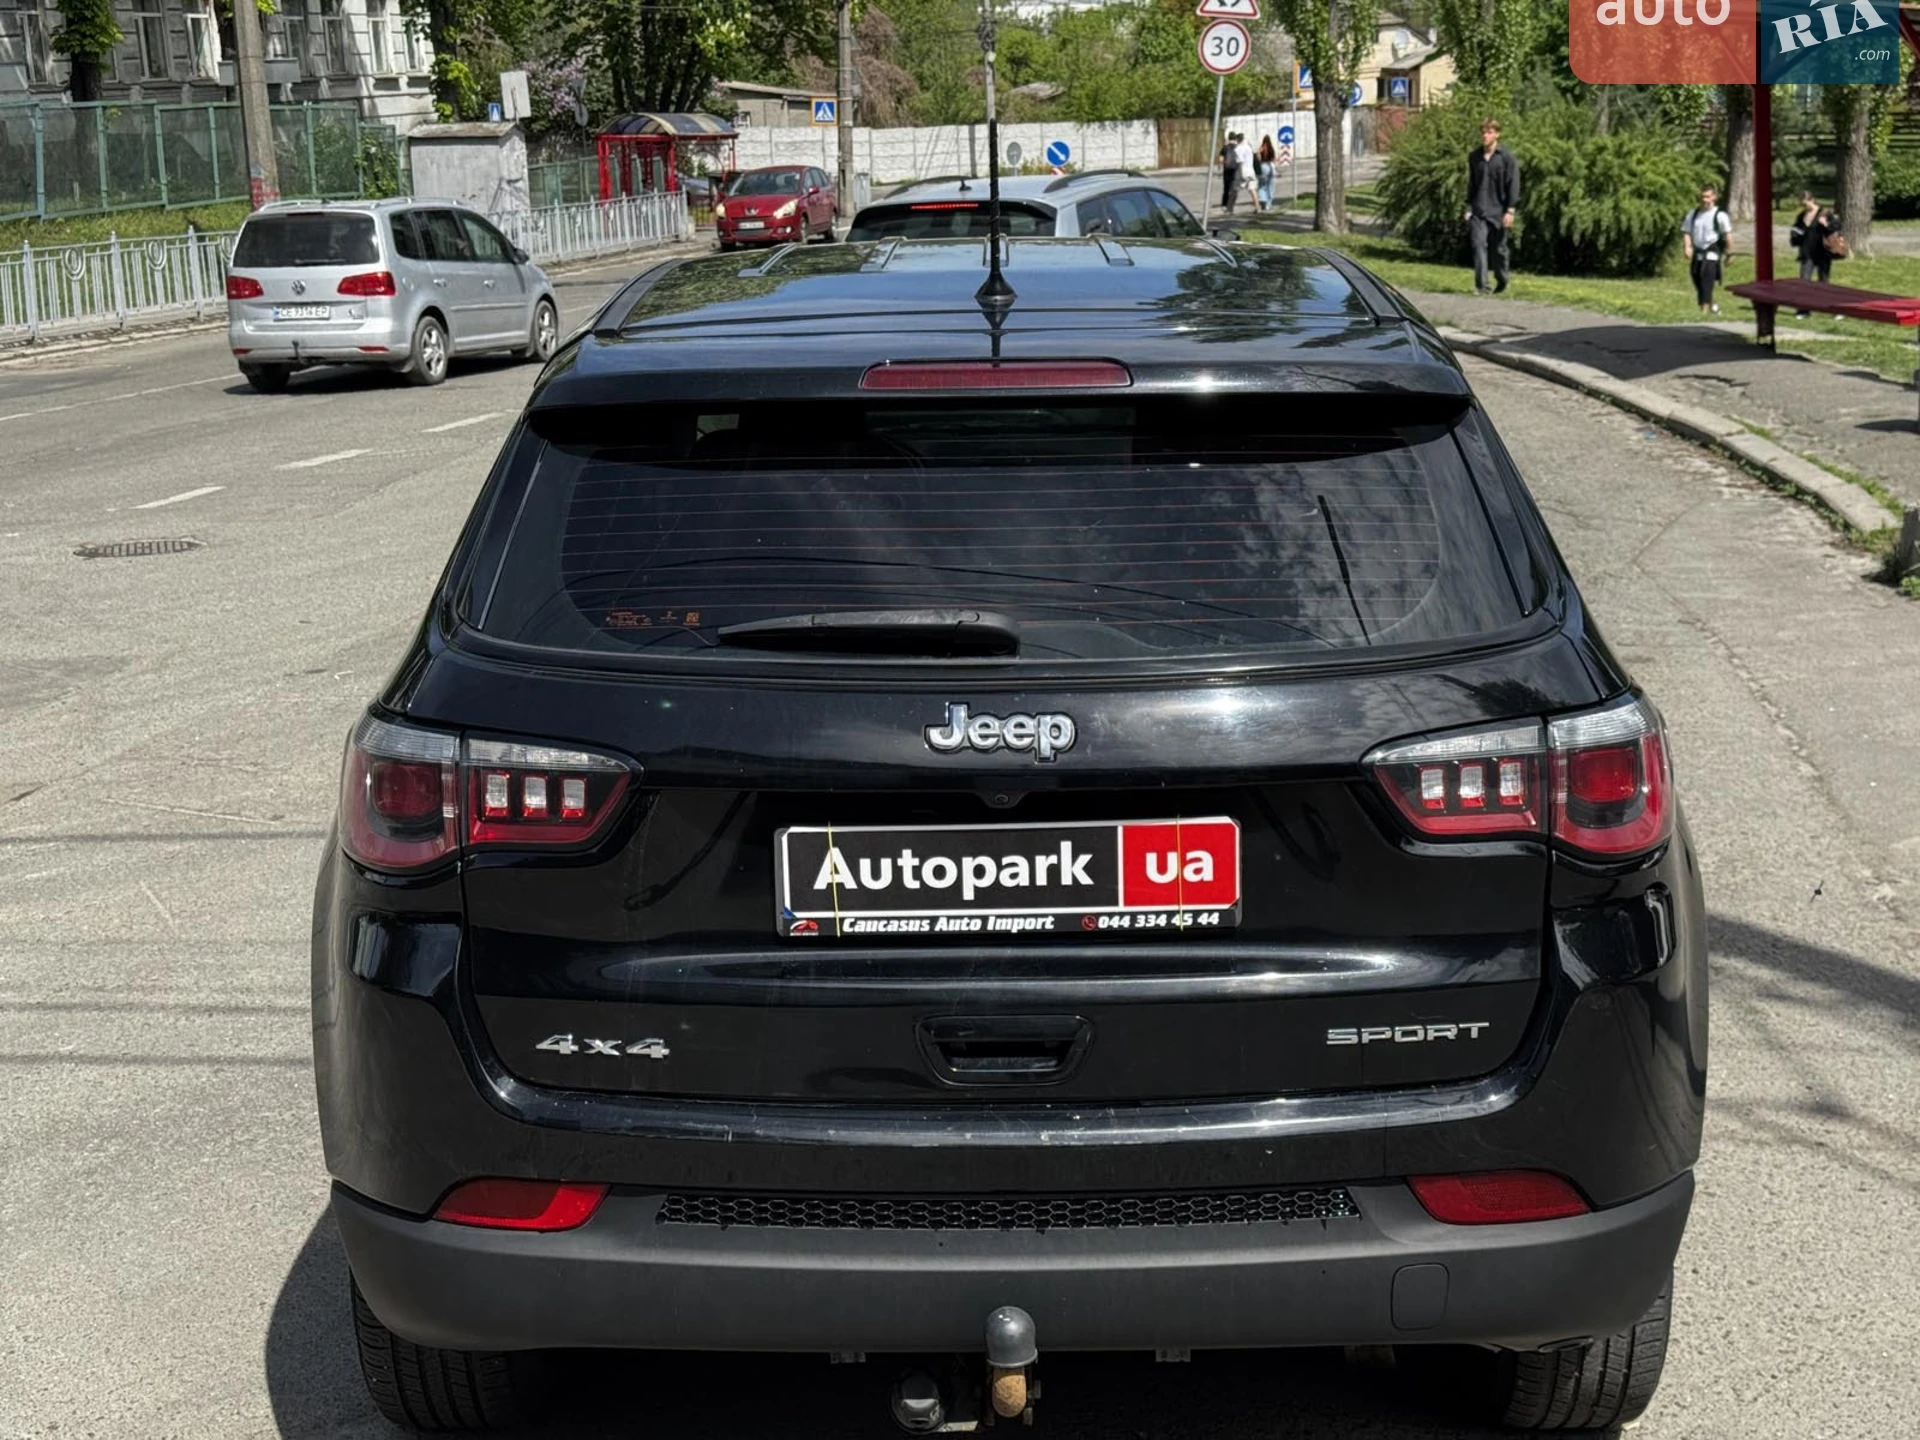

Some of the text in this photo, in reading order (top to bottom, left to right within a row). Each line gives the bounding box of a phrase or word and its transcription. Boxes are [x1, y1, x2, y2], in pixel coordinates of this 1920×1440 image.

[1210, 36, 1240, 57] 30
[925, 702, 1077, 762] Jeep
[813, 841, 1214, 900] Autopark ua
[842, 915, 1055, 933] Caucasus Auto Import
[1098, 912, 1220, 929] 044 334 45 44
[1326, 1022, 1490, 1045] SPORT
